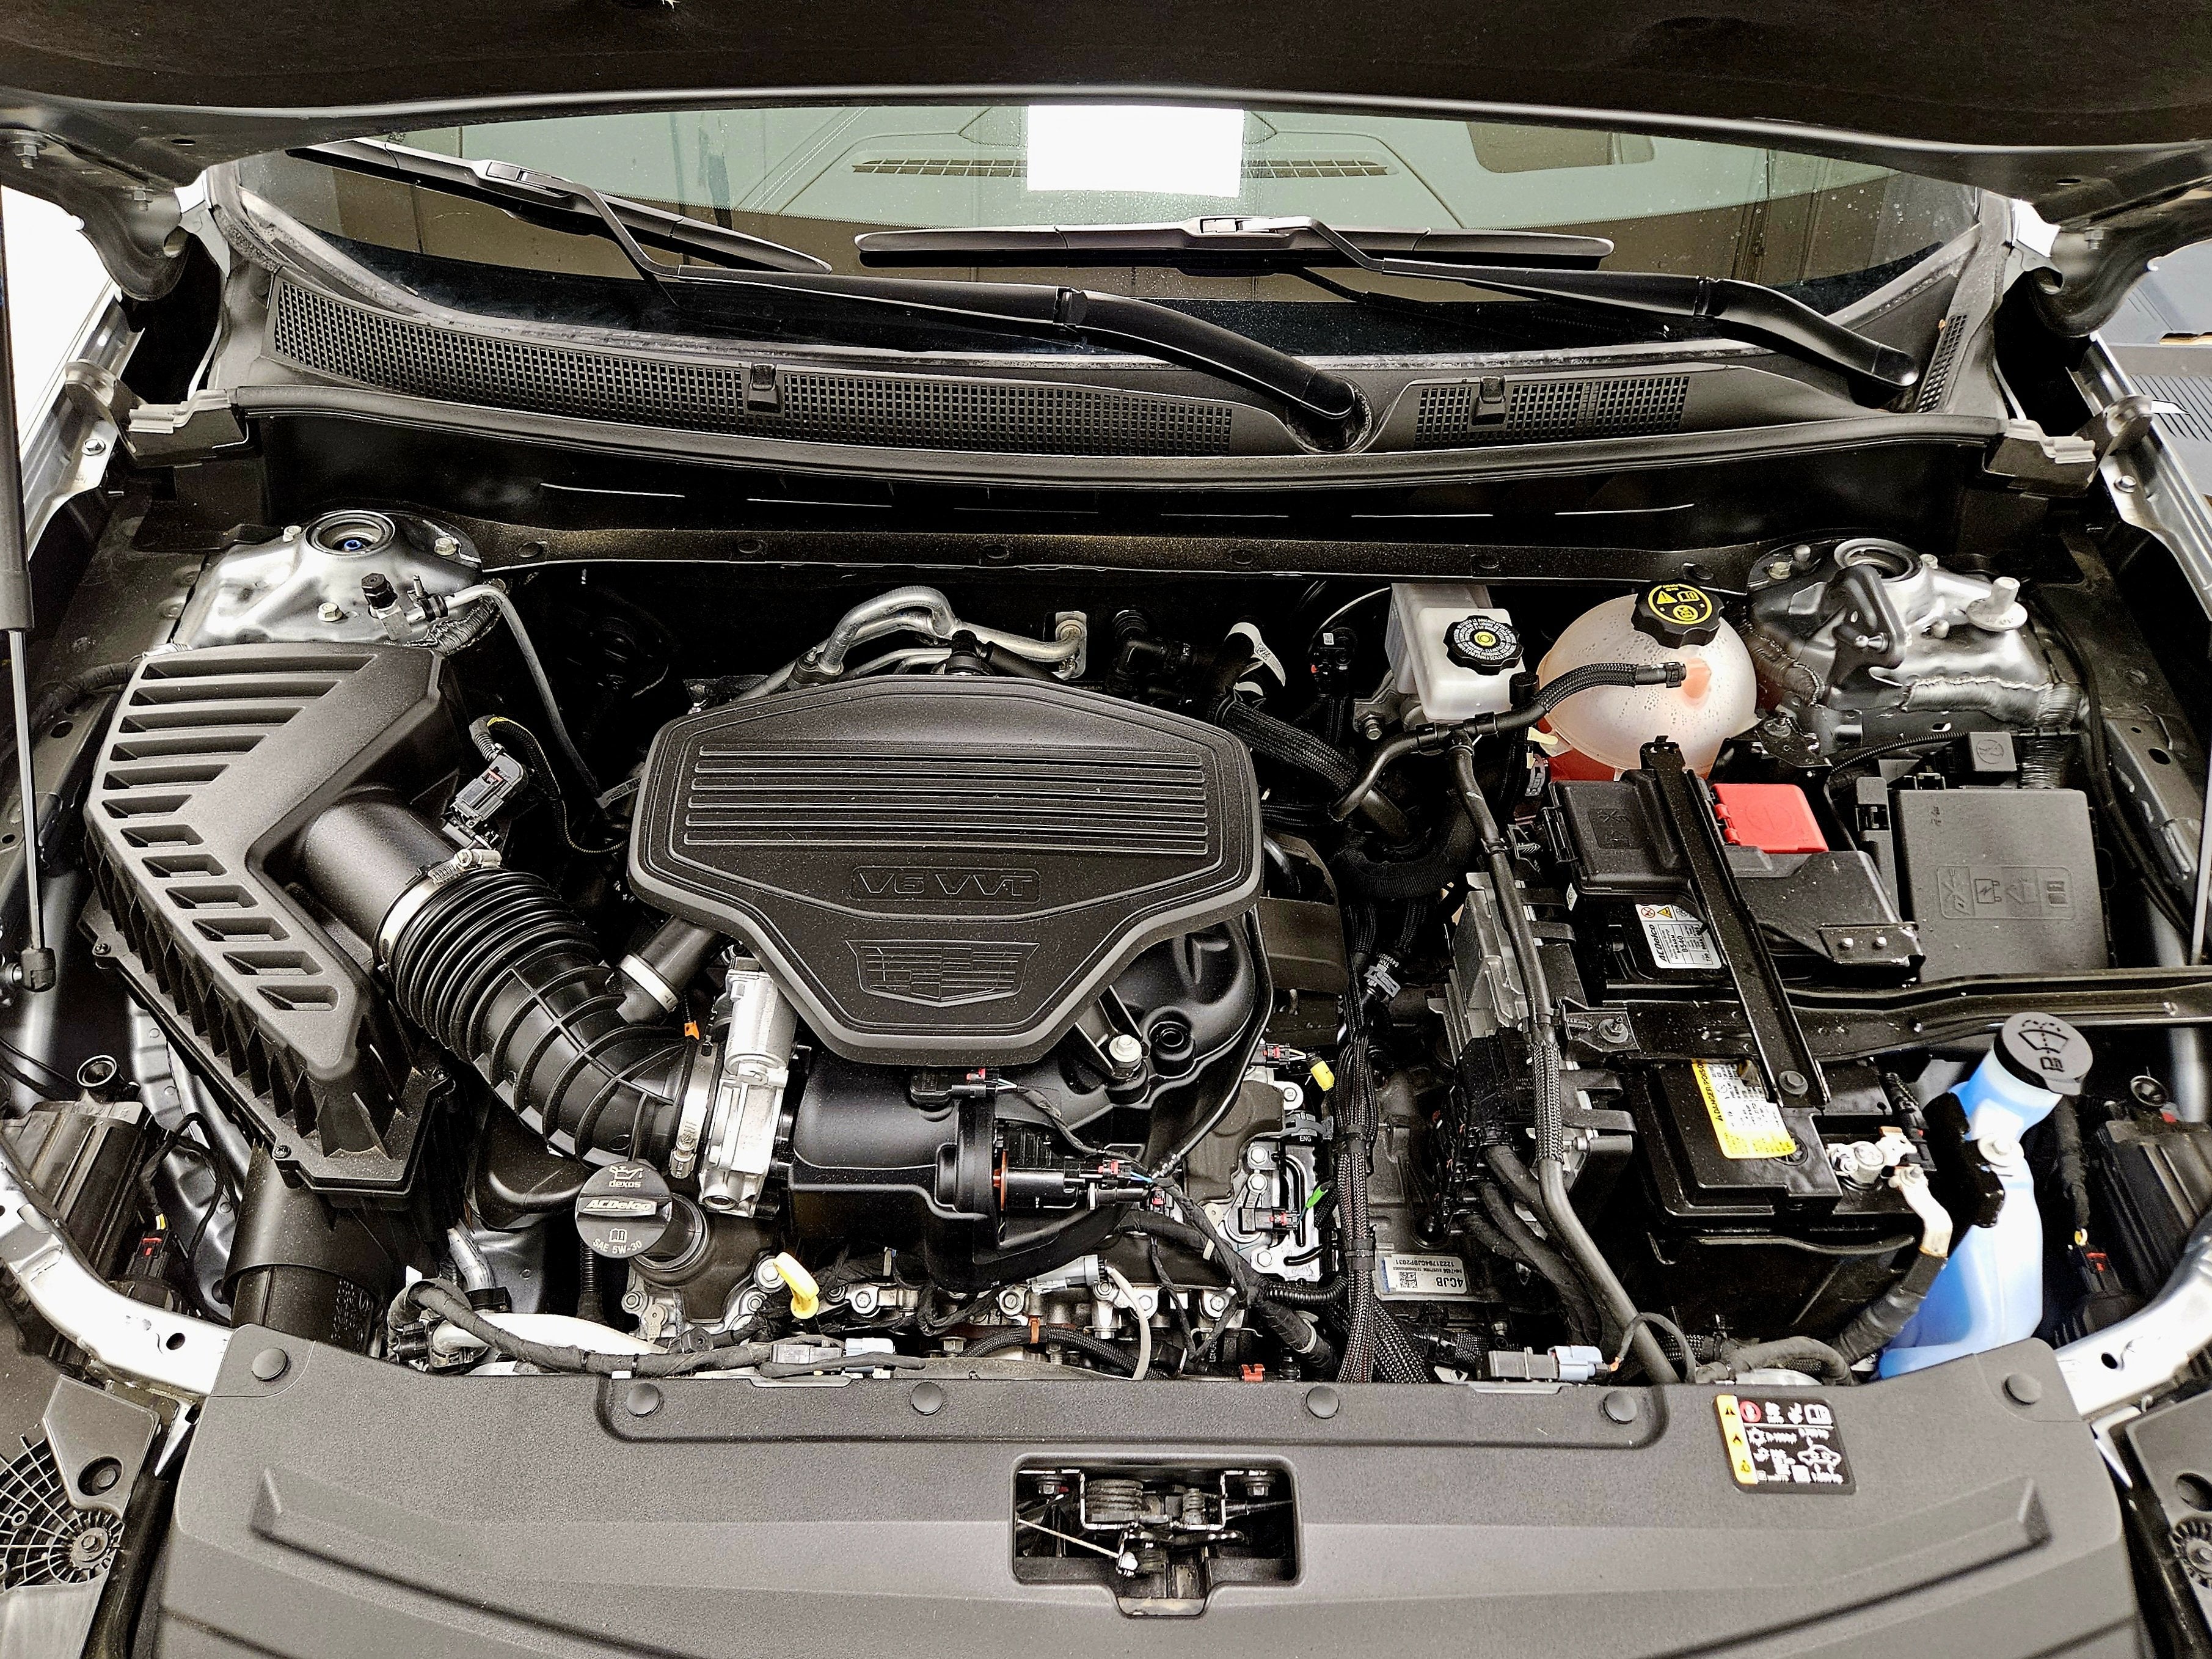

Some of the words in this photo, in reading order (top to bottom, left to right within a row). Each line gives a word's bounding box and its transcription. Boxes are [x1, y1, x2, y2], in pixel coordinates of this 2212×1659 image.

[859, 872, 925, 894] V6
[935, 873, 1032, 896] VVT
[1649, 924, 1667, 962] ACDelco
[608, 1179, 641, 1188] dexos
[585, 1199, 652, 1211] ACDelco
[593, 1238, 610, 1253] SAE
[612, 1240, 643, 1254] 5W-30
[1436, 1276, 1464, 1288] 4CJB
